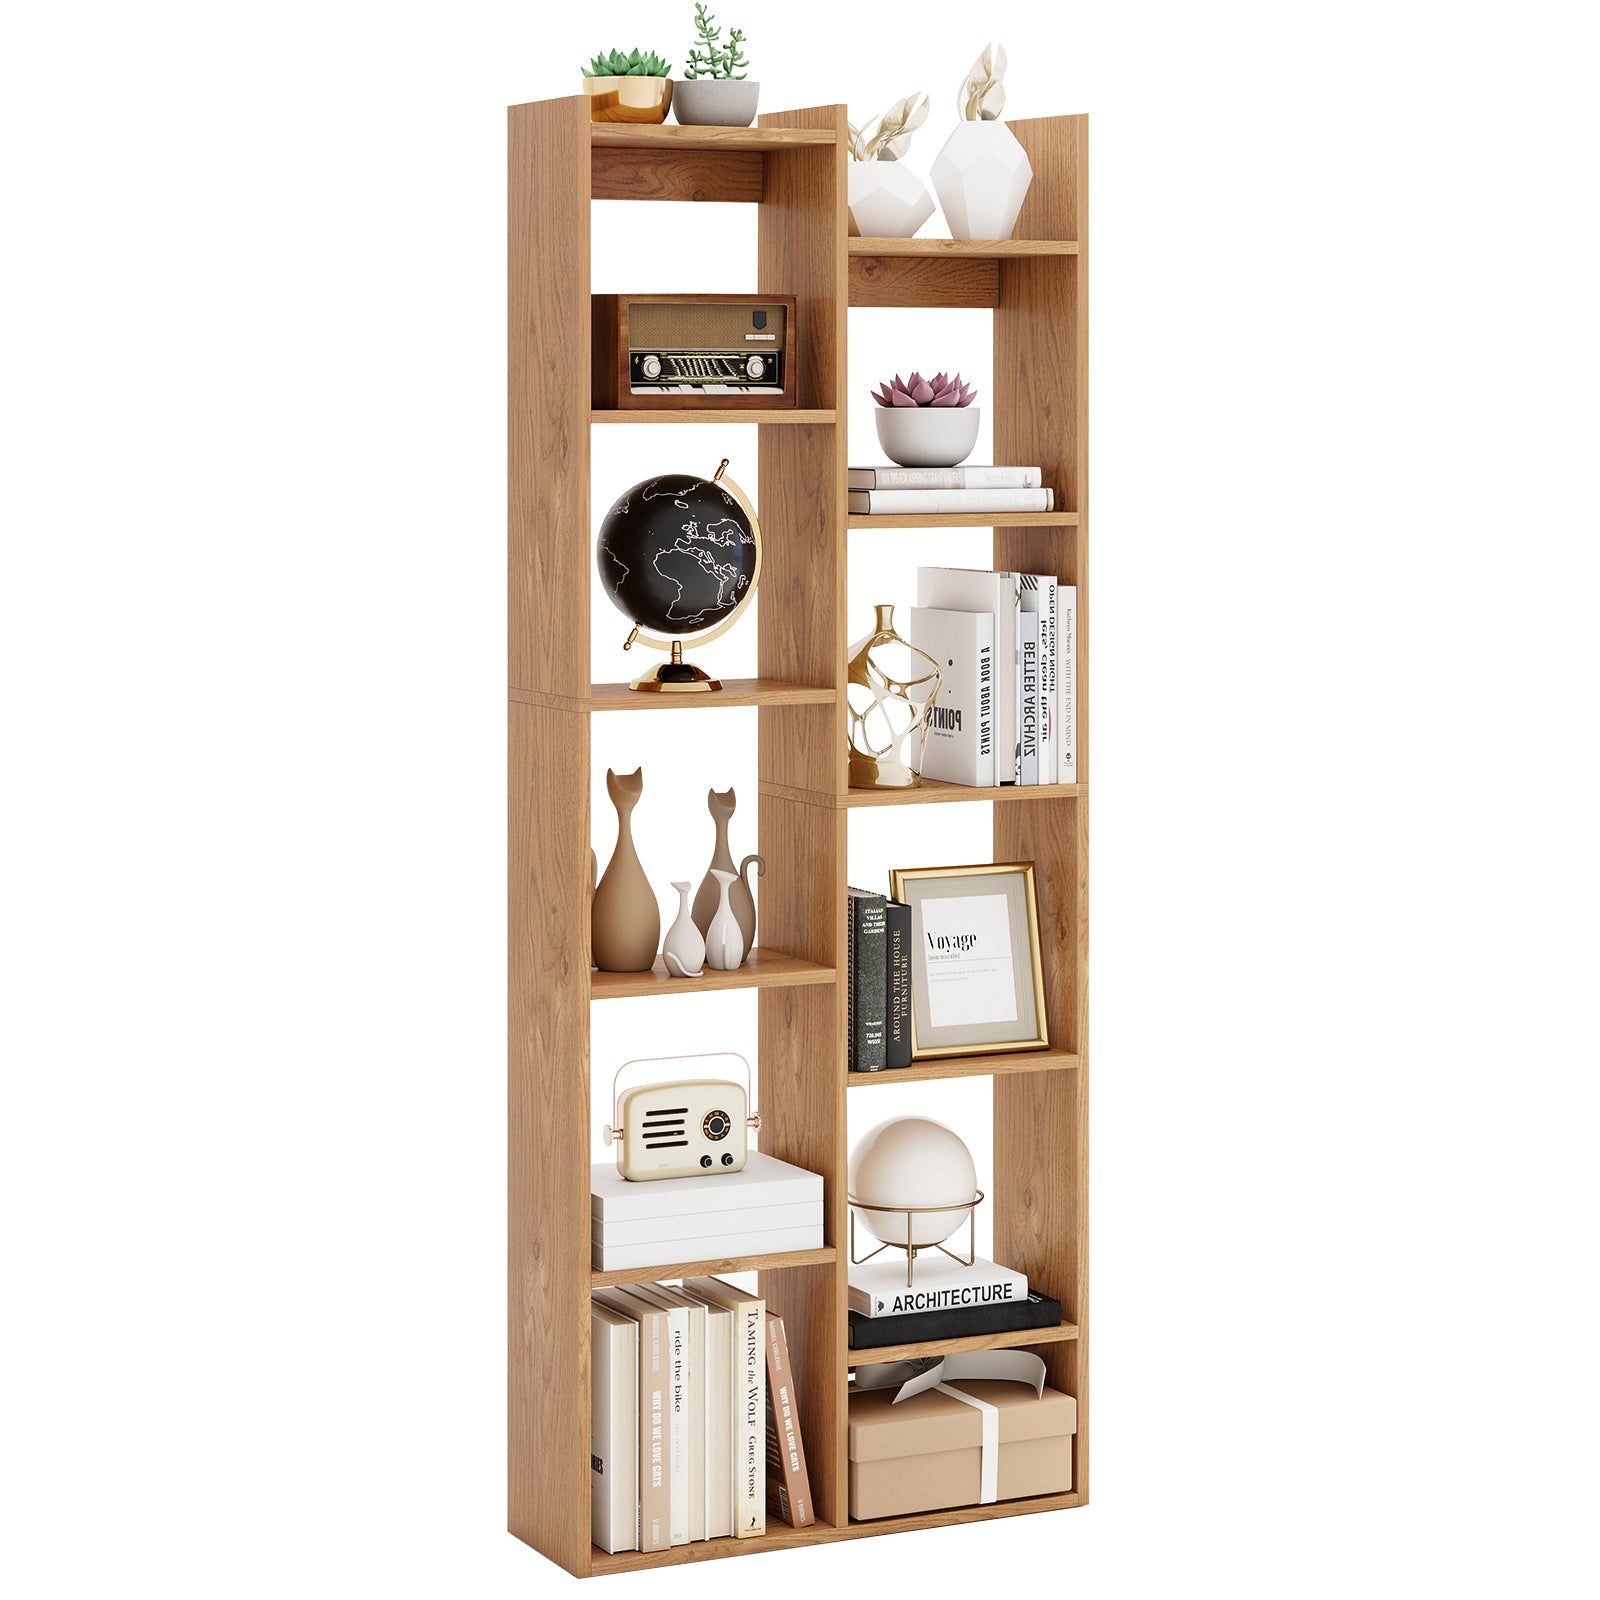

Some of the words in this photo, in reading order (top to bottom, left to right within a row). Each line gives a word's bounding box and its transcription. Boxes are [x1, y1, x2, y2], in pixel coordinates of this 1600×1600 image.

[1066, 714, 1072, 724] IN
[928, 932, 977, 952] Voyage
[892, 1283, 1013, 1313] ARCHITECTURE
[674, 1330, 682, 1356] ride
[748, 1309, 759, 1366] TAMING
[674, 1360, 682, 1382] the
[748, 1370, 756, 1384] the
[652, 1390, 662, 1410] WHY
[674, 1385, 682, 1414] bike
[779, 1386, 788, 1405] WHY
[748, 1386, 759, 1426] WOLF
[782, 1406, 790, 1416] DO
[652, 1412, 662, 1425] DO
[784, 1418, 792, 1432] WE
[652, 1426, 662, 1440] WE
[788, 1432, 796, 1452] LOVE
[652, 1442, 662, 1464] LOVE
[748, 1436, 757, 1464] GREG
[791, 1453, 800, 1472] CATS
[652, 1465, 662, 1488] CATS
[748, 1466, 757, 1499] STONE
